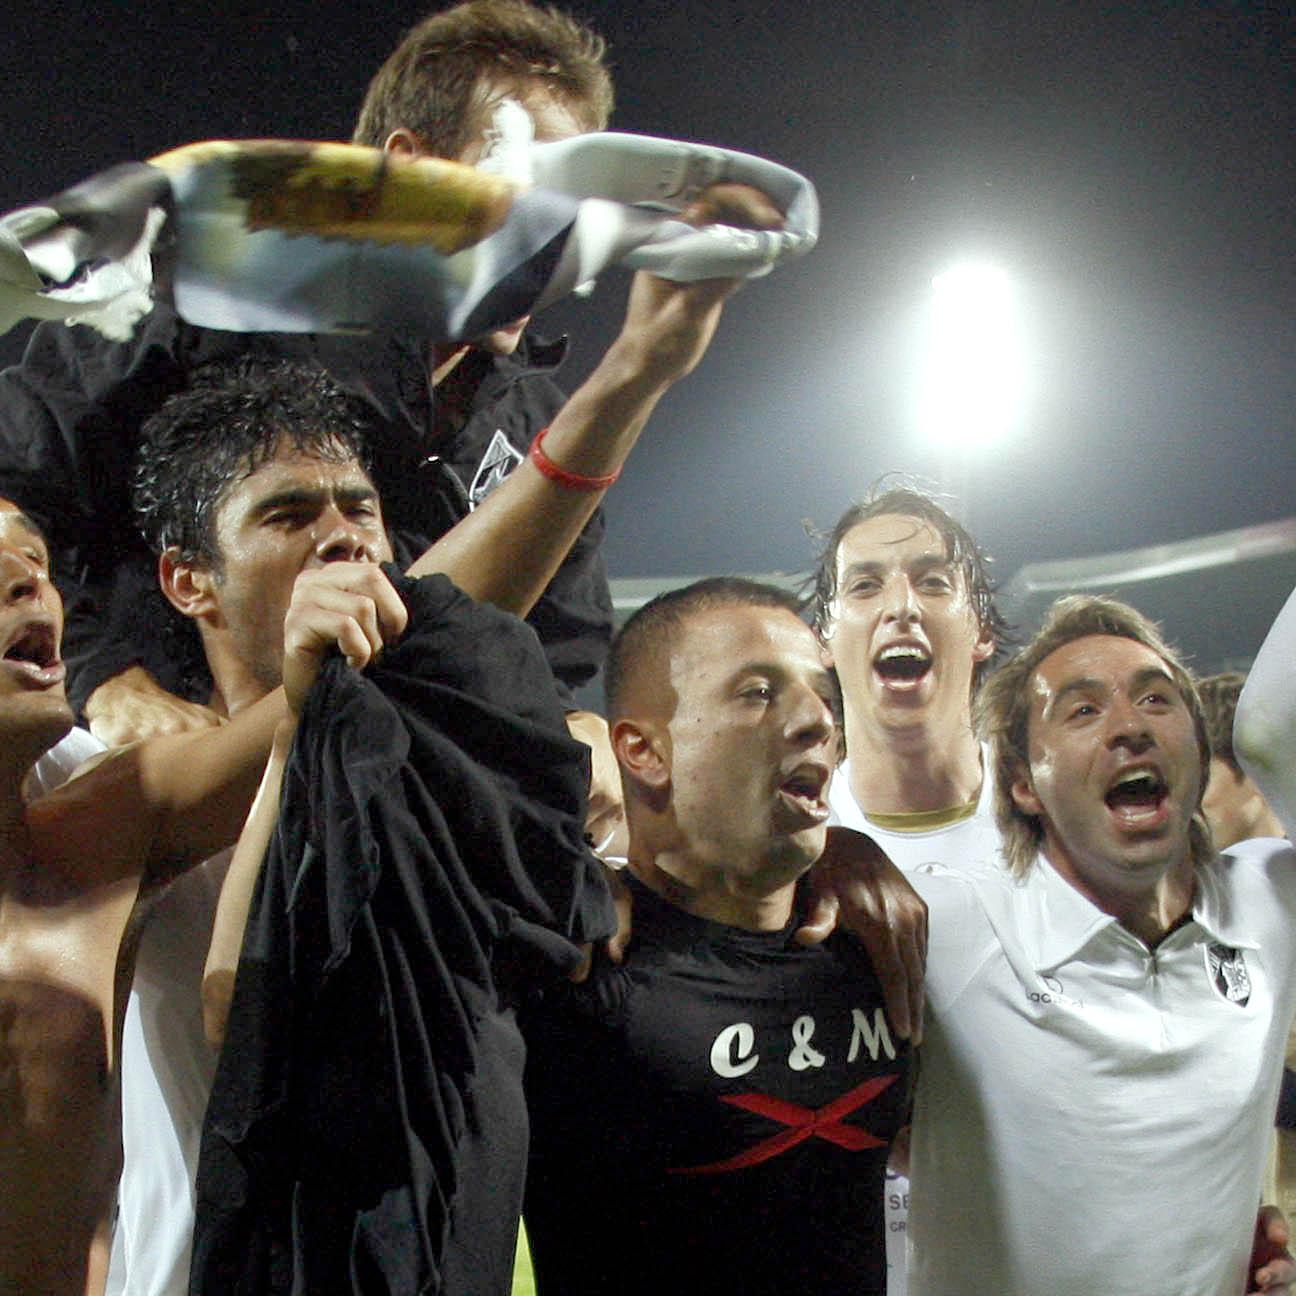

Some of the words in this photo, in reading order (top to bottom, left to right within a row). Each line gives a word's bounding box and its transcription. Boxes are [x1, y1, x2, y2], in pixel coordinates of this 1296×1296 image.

[710, 1022, 759, 1078] C
[788, 1015, 826, 1071] &
[847, 1007, 896, 1063] M
